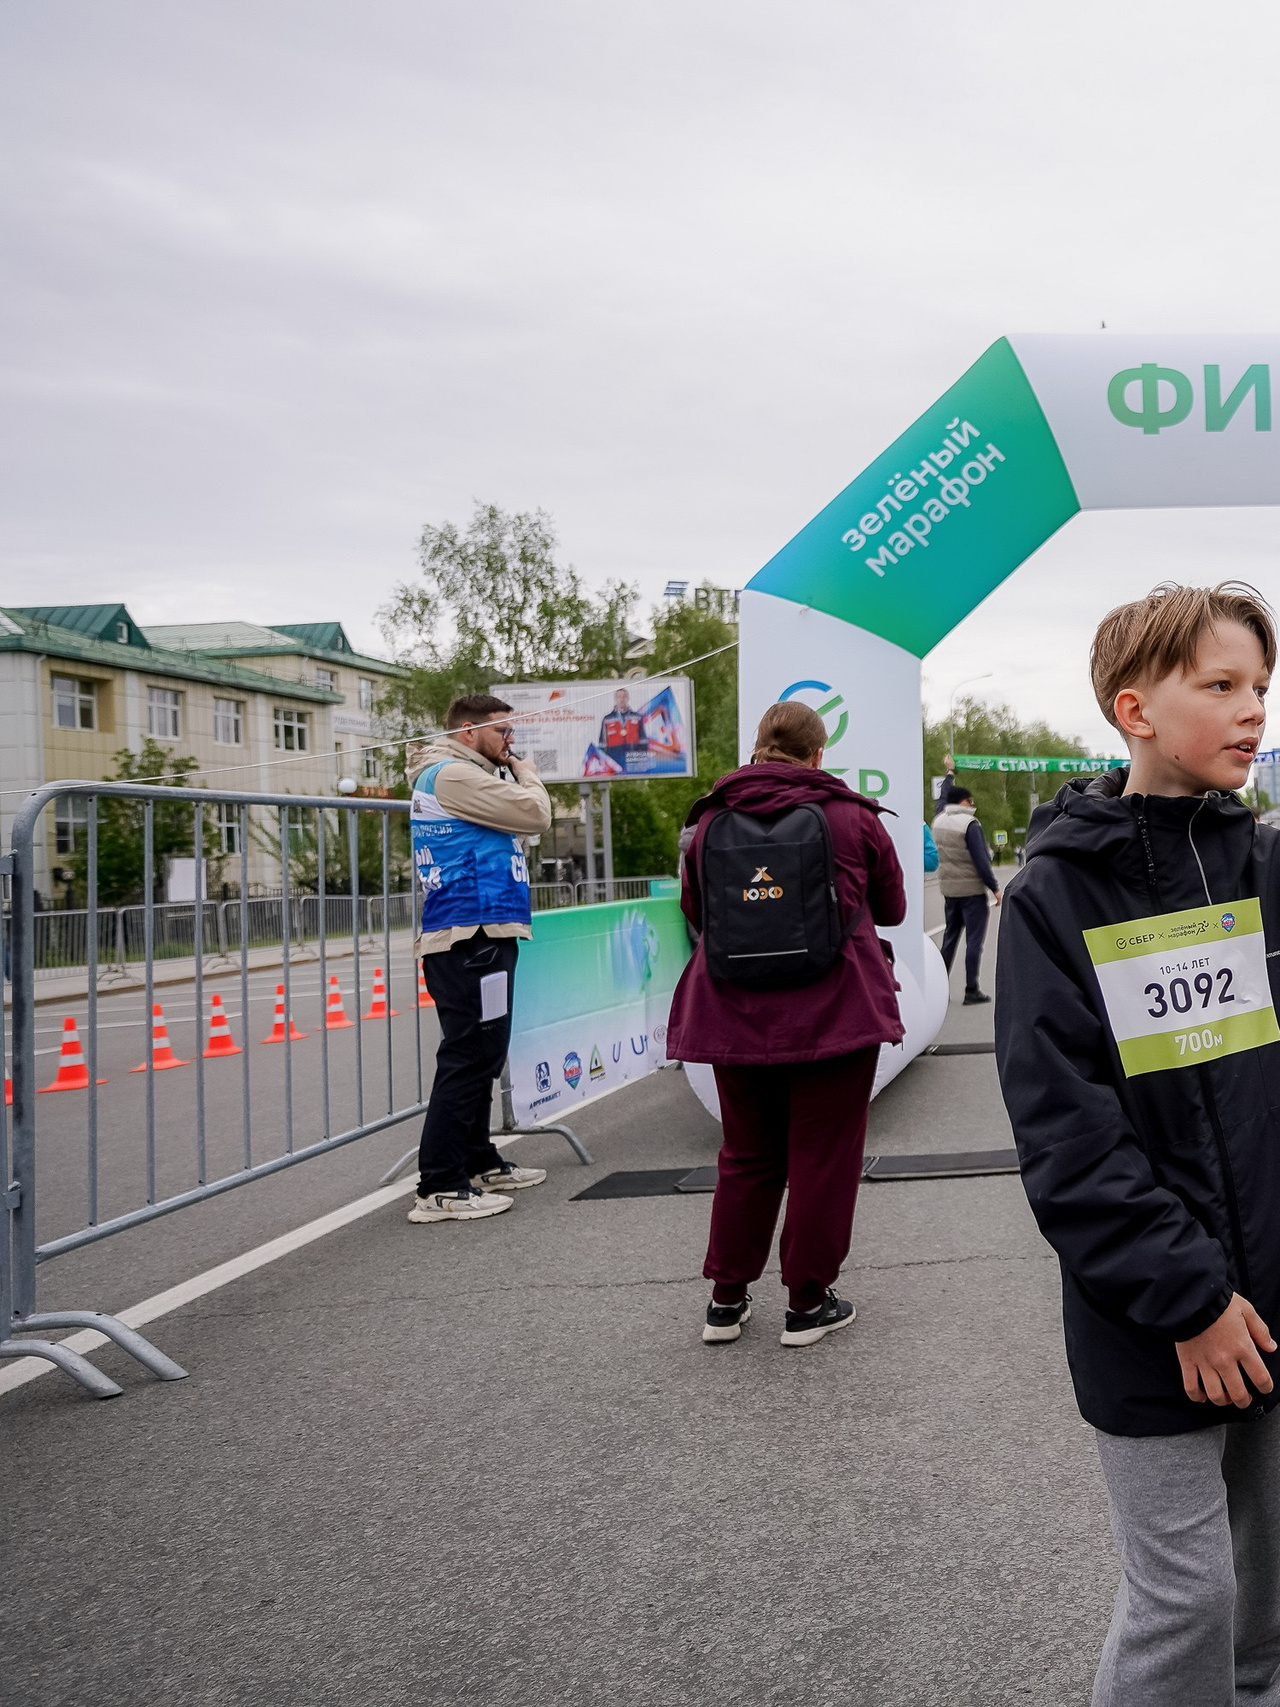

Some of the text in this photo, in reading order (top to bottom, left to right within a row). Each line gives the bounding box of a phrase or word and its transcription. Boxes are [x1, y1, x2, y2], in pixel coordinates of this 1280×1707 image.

[841, 416, 981, 552] зелёный
[864, 442, 1006, 578] марафон
[997, 758, 1049, 771] СТАРТ
[1058, 760, 1111, 772] СТАРТ
[1129, 933, 1155, 945] СБЕР
[1168, 929, 1196, 939] марафон
[1160, 957, 1210, 975] 10-14 ЛЕТ
[1144, 967, 1235, 1019] 3092
